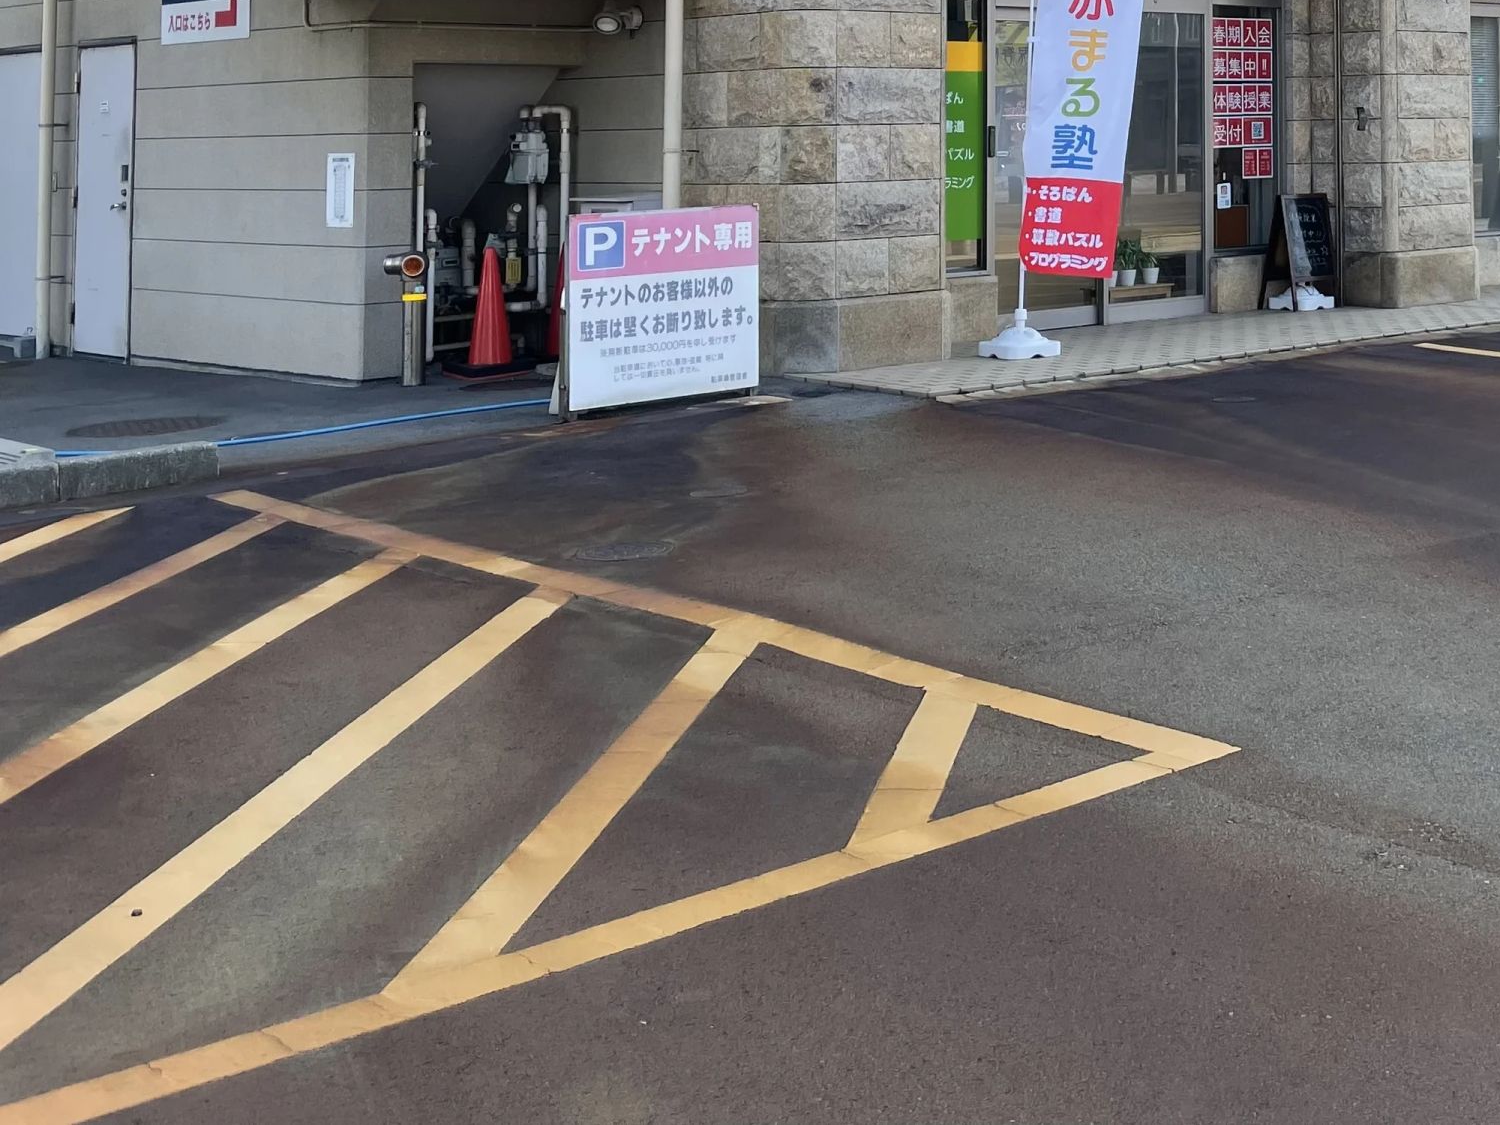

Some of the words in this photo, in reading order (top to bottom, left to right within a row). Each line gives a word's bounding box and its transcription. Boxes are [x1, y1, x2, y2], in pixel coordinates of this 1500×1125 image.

[168, 12, 211, 33] 入口はこちら
[1213, 26, 1271, 44] 春期入会
[1213, 91, 1271, 110] 体験授業
[1214, 124, 1242, 143] 受付
[585, 227, 618, 266] P
[631, 221, 753, 257] テナント専用
[580, 276, 733, 309] テナントのお客様以外の
[580, 305, 753, 343] 駐車は堅くお断り致します。
